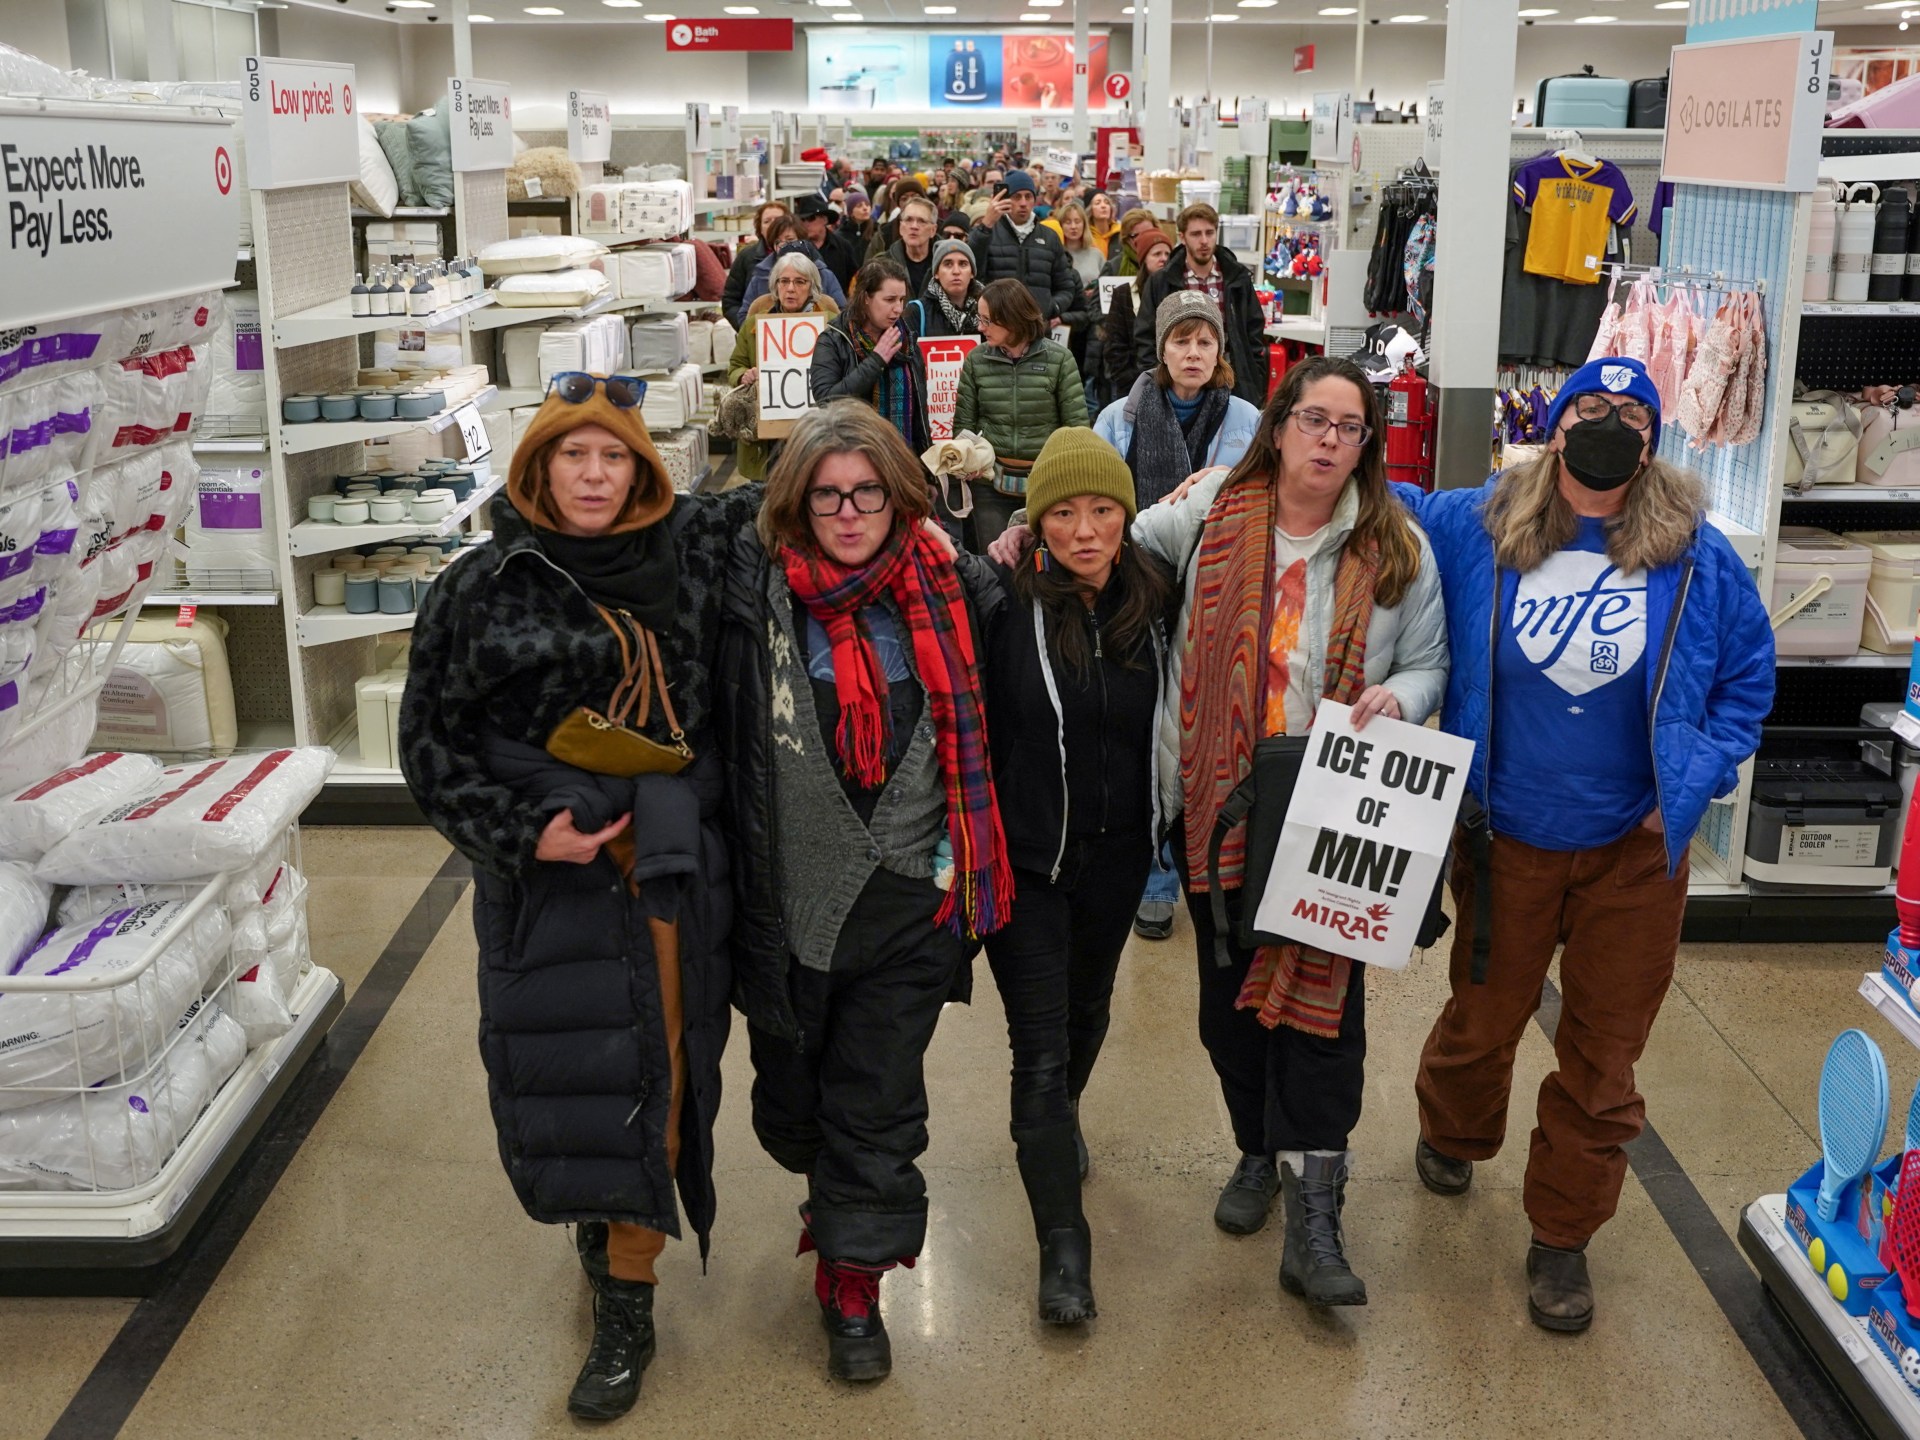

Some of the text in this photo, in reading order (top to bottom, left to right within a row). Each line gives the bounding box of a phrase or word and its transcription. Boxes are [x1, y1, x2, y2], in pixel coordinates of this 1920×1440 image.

[694, 26, 719, 37] Bath
[270, 79, 335, 123] Low price!
[467, 93, 487, 118] Expect
[581, 102, 595, 122] Expect
[469, 117, 481, 140] Pay
[582, 120, 590, 139] Pay
[1, 143, 146, 203] Expect More.
[9, 199, 113, 258] Pay Less.
[1102, 284, 1116, 293] IC
[763, 319, 820, 362] NO
[932, 392, 948, 403] OUT
[1597, 658, 1612, 668] 59
[1316, 731, 1456, 801] ICE OUT
[1356, 796, 1390, 828] OF
[1799, 841, 1826, 849] COOLER
[1800, 833, 1832, 841] OUTDOOR
[1307, 826, 1412, 898] MN!
[1291, 898, 1388, 942] MIRAC
[1884, 950, 1916, 989] SPORTS
[0, 1031, 41, 1050] ARNING:
